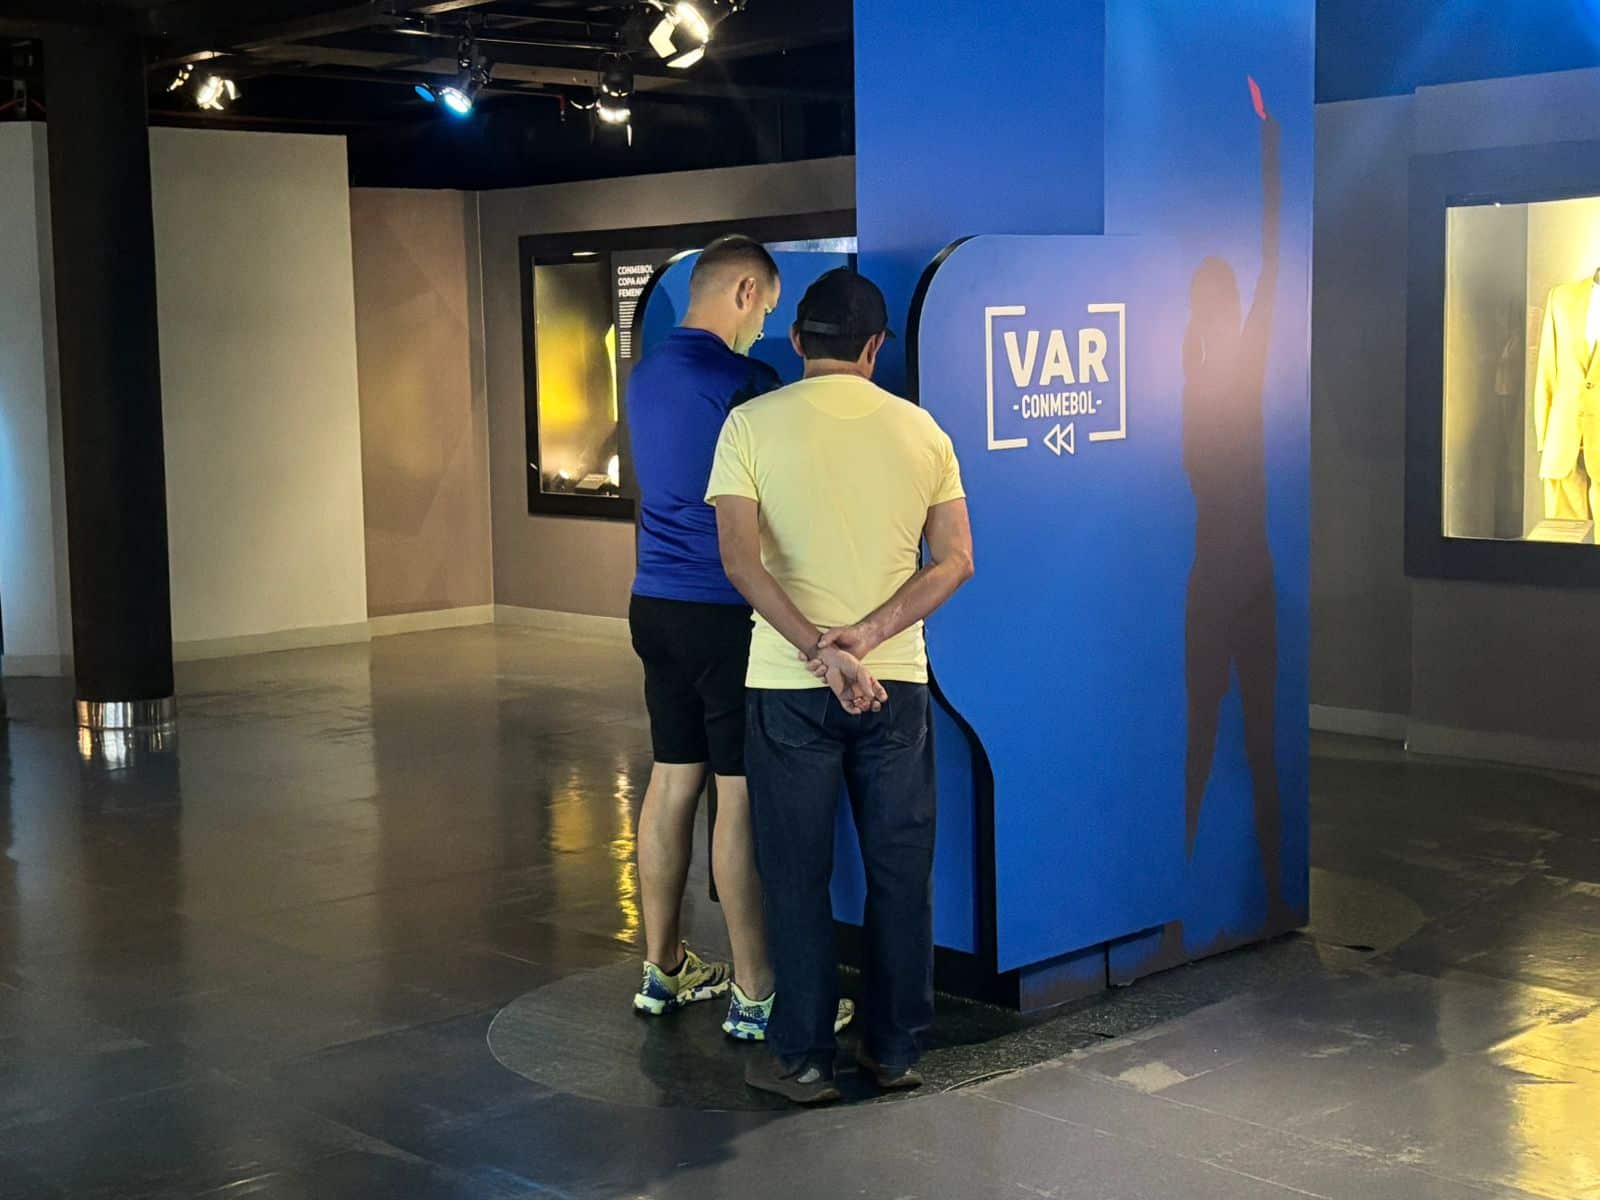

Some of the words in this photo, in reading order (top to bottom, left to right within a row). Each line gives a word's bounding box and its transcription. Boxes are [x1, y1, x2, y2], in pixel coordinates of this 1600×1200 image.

[618, 265, 654, 275] CONMEBOL
[618, 277, 636, 286] COPA
[1003, 327, 1109, 388] VAR
